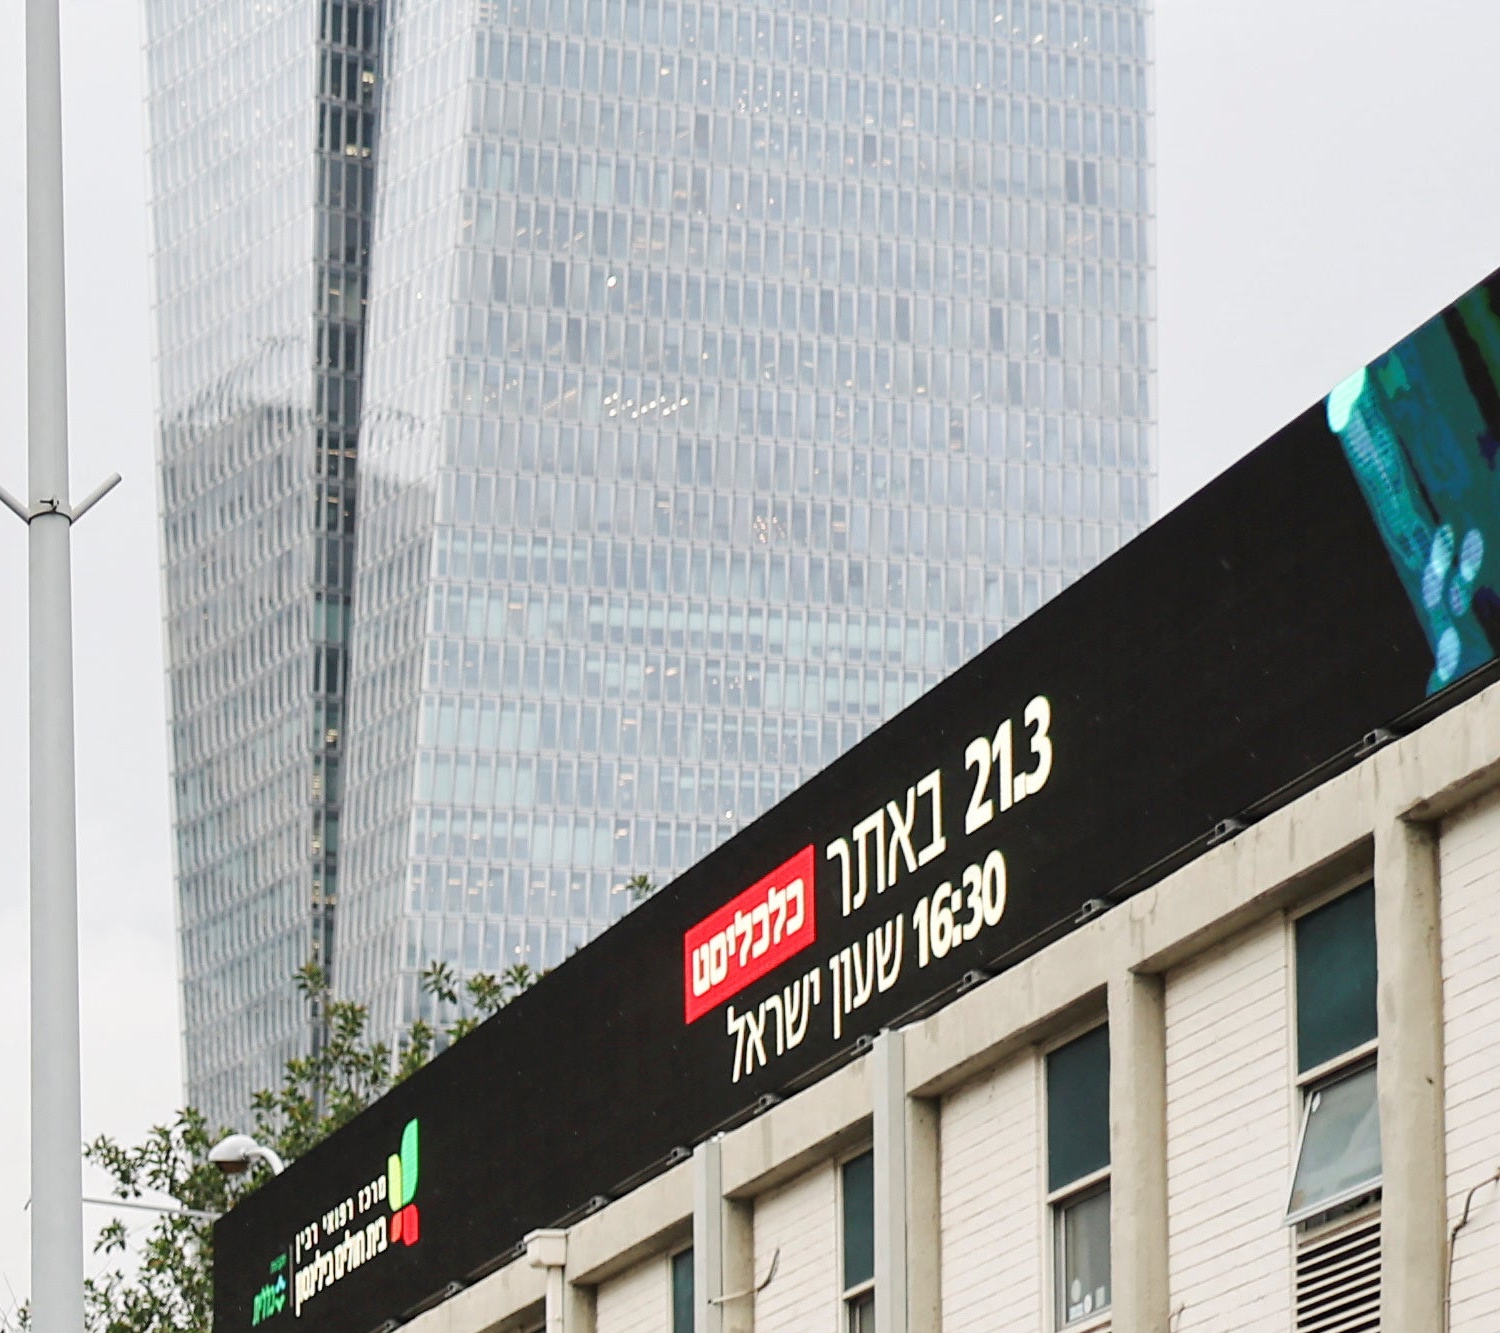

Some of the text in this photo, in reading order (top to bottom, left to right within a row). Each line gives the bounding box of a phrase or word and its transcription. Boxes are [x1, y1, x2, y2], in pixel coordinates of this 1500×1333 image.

[691, 694, 1054, 998] 21.3 באתר כלכליסט
[726, 849, 1008, 1083] 16:30 שעון ישראל
[321, 1197, 354, 1235] רפואי
[358, 1174, 387, 1213] מרכז
[295, 1222, 319, 1264] רבין
[334, 1229, 366, 1280] חולים
[365, 1215, 387, 1261] בית
